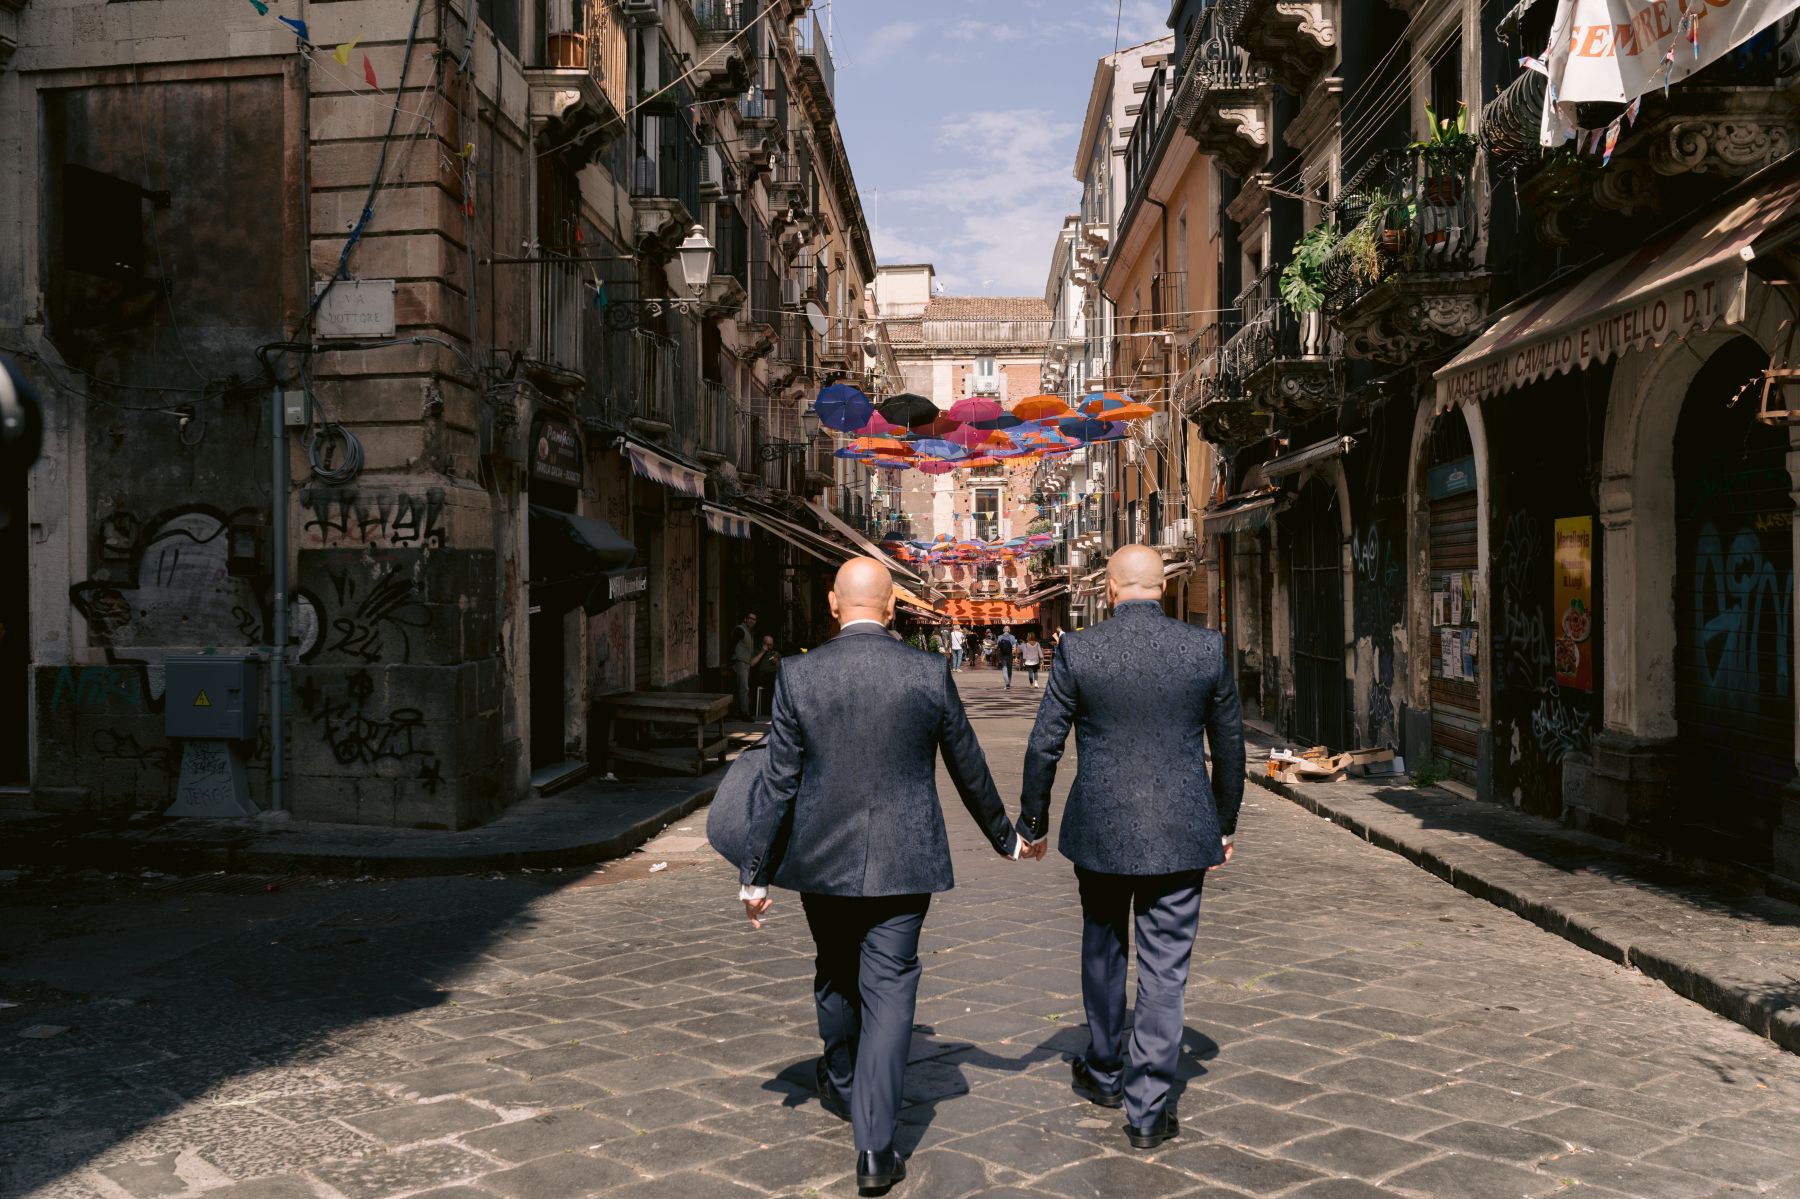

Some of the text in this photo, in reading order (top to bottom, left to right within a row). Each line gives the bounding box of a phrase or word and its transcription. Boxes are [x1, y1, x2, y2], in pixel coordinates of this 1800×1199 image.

[328, 312, 381, 323] DOTTORE
[1446, 360, 1509, 401] MACELLERIA
[1515, 335, 1572, 377] CAVALLO
[1579, 328, 1590, 358] E
[1597, 299, 1667, 352] VITELLO
